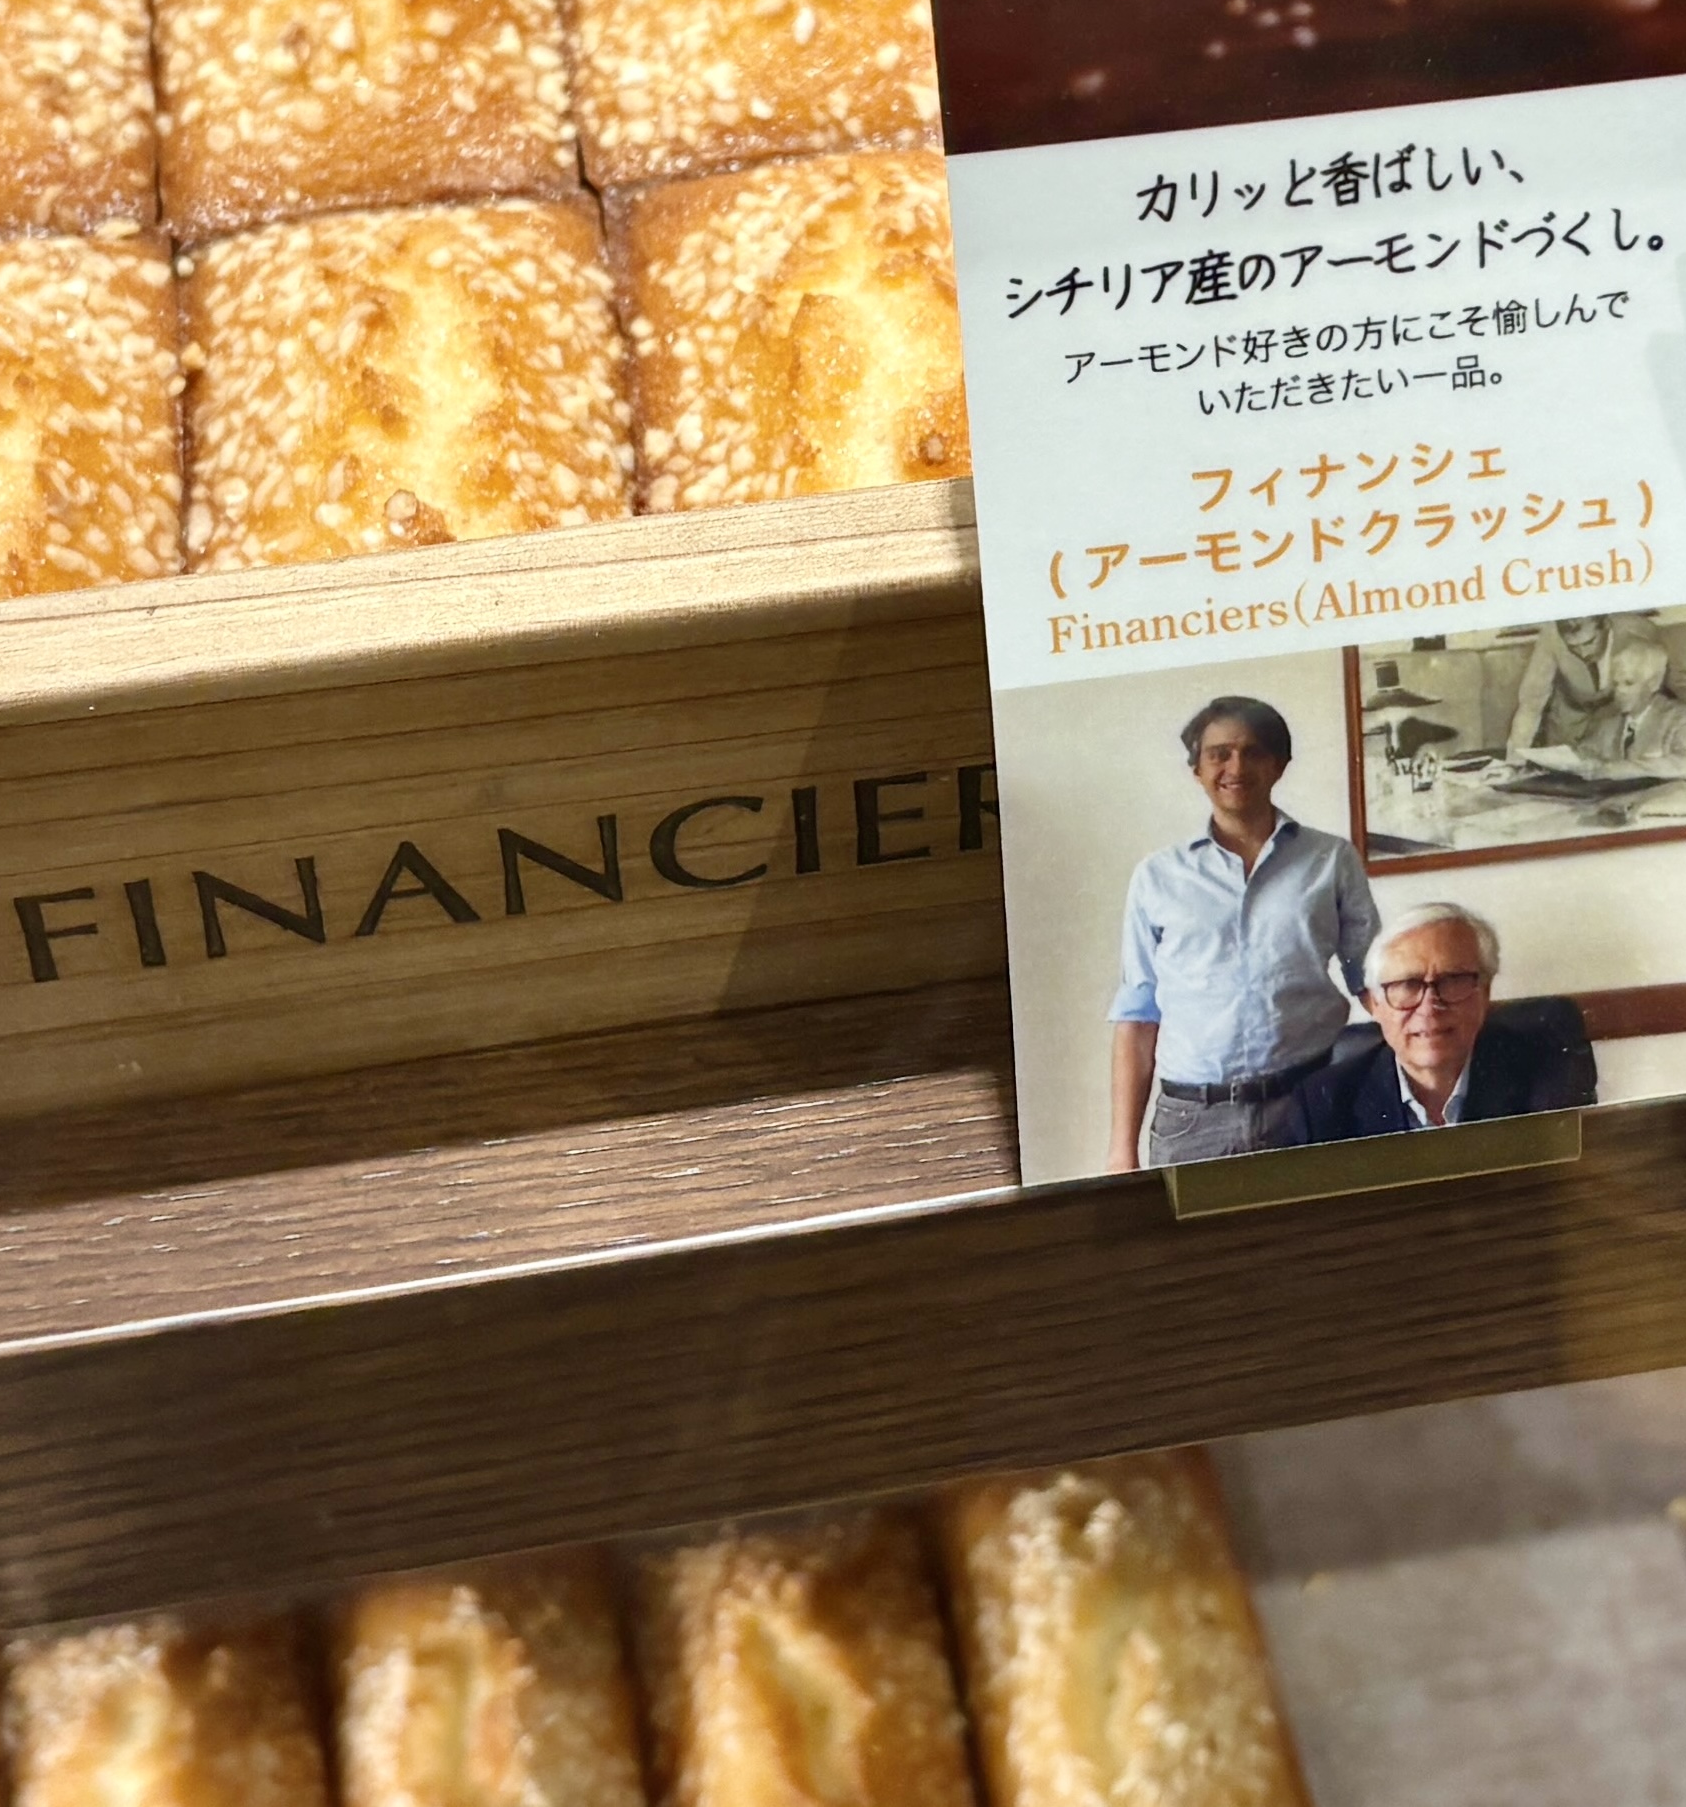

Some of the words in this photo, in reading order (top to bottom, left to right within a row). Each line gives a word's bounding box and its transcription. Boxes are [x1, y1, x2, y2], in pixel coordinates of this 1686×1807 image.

[1137, 144, 1523, 222] カリッと香ばしい、
[1007, 209, 1663, 318] シチリア産のアーモンドづくし。
[1066, 292, 1627, 383] アーモンド好きの方にこそ愉しんで
[1199, 355, 1501, 415] いただきたい一品。
[1192, 444, 1507, 513] フィナンシェ
[1050, 566, 1486, 655] Financiers(Almond
[1502, 545, 1653, 597] Crush)
